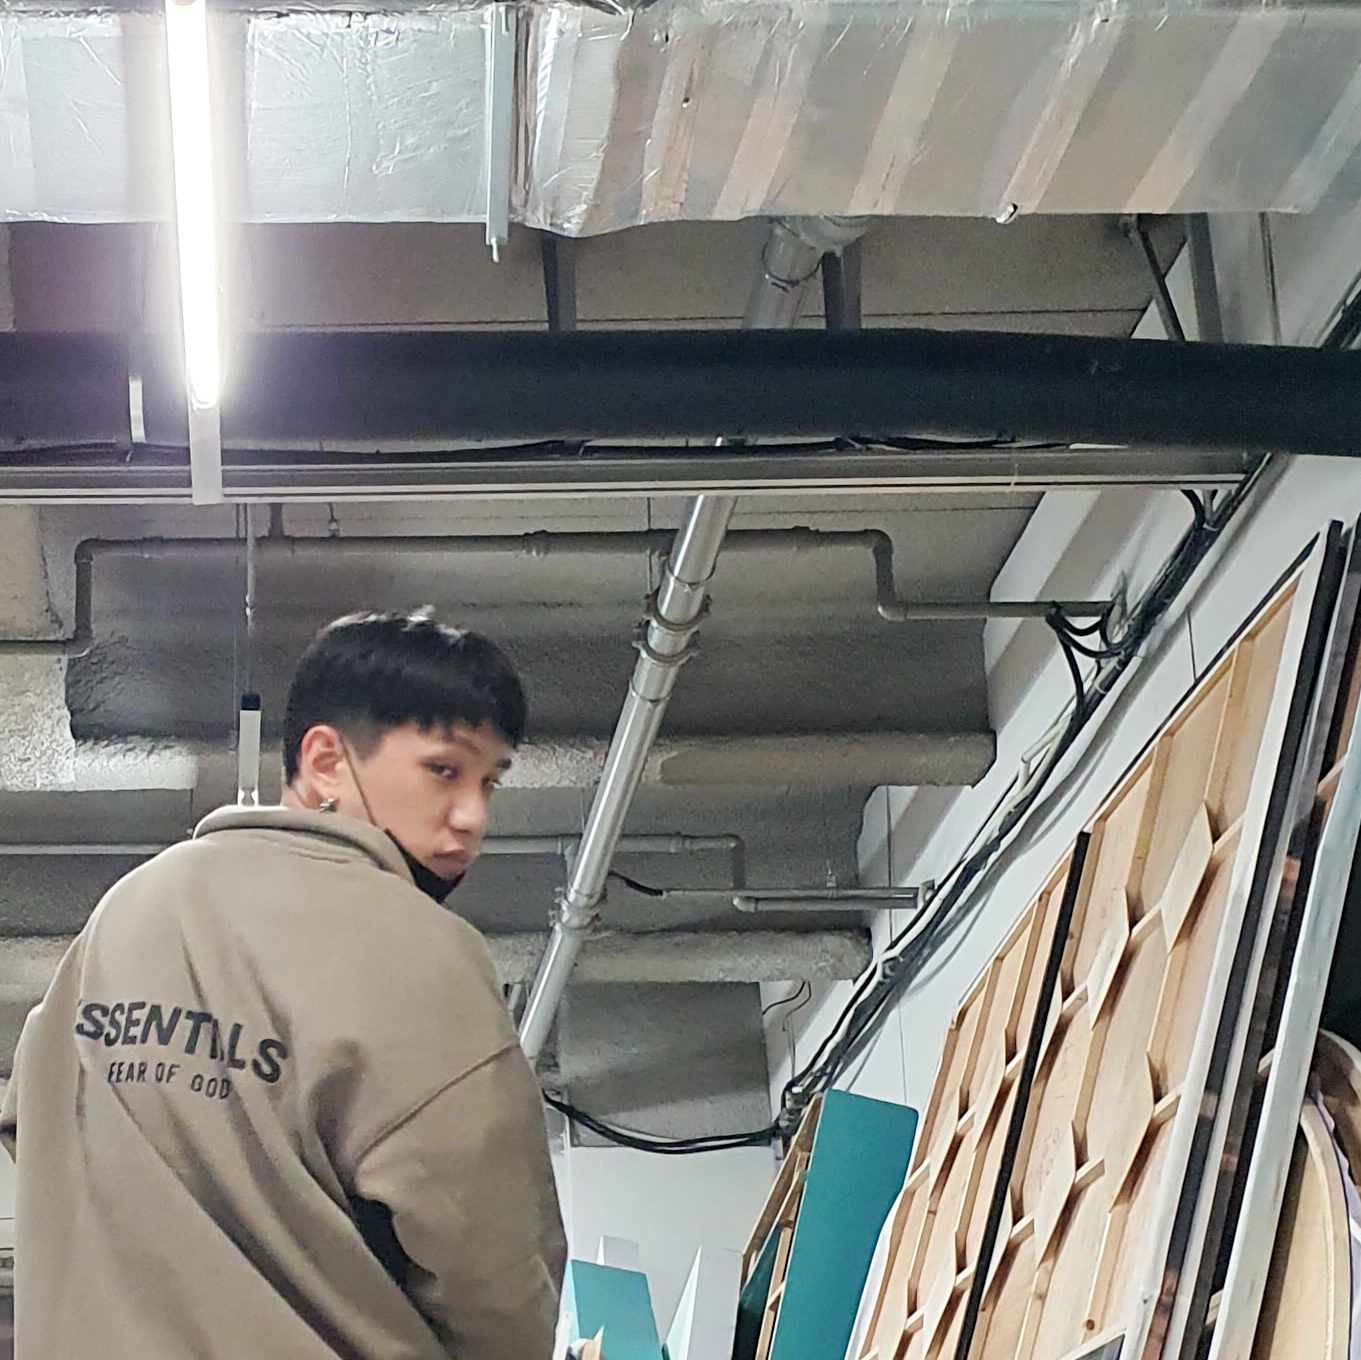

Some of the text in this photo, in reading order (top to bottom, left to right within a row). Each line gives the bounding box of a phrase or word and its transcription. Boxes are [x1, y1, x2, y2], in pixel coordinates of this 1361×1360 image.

[75, 1001, 288, 1084] SSENTILS
[107, 1061, 232, 1100] FEAR OF GOD
